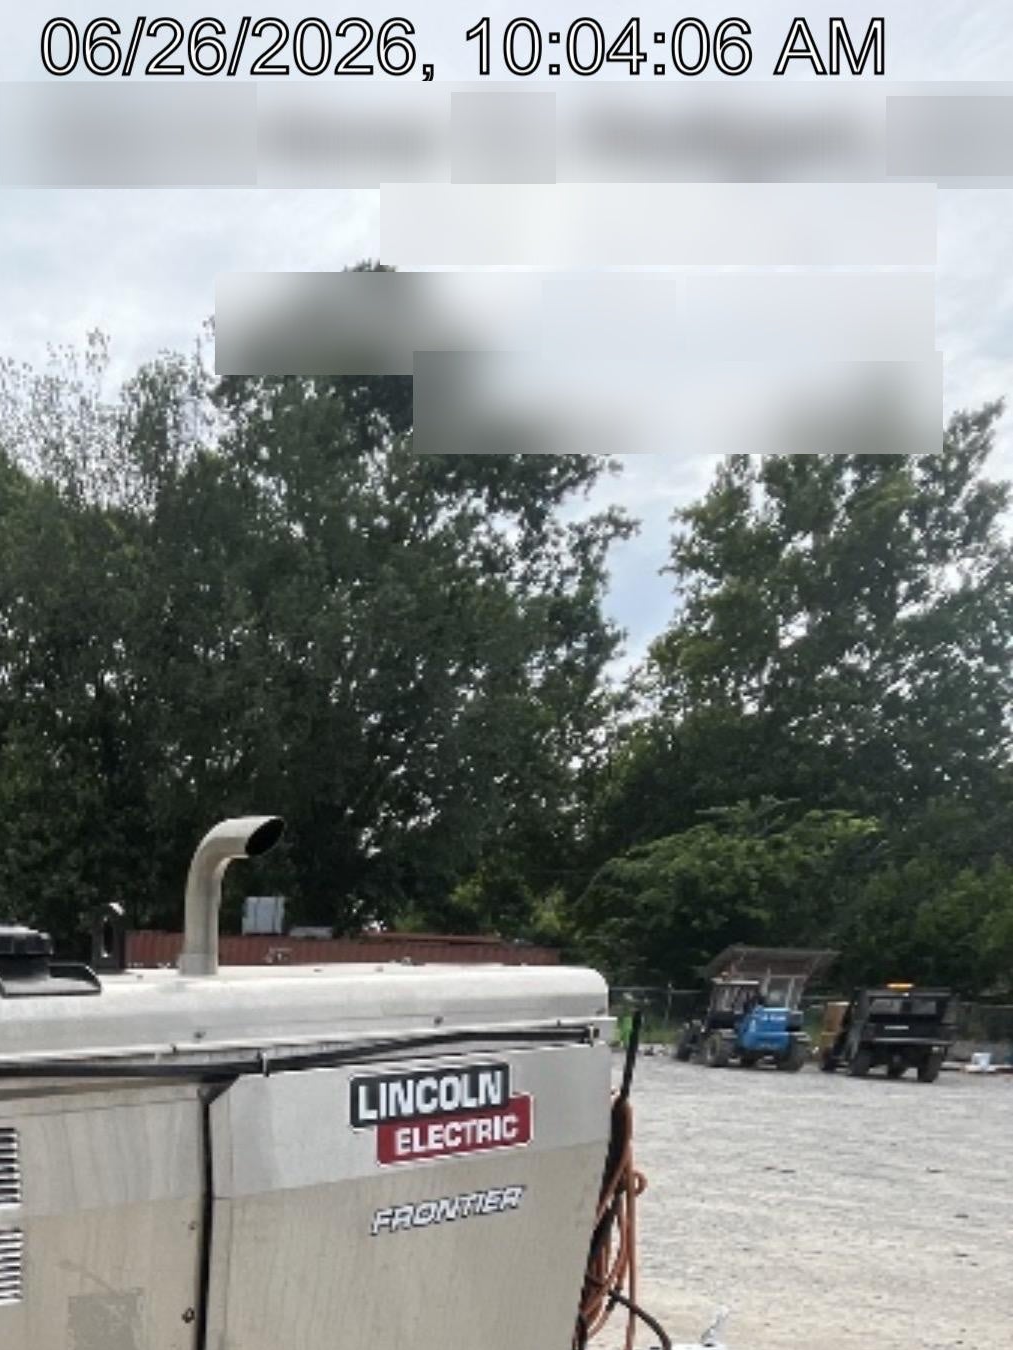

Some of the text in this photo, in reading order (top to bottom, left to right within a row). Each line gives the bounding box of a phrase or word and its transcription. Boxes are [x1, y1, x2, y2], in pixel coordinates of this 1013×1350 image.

[358, 1070, 503, 1121] LINCOLN
[394, 1114, 519, 1155] ELECTRIC
[371, 1186, 525, 1236] FRONTIER
